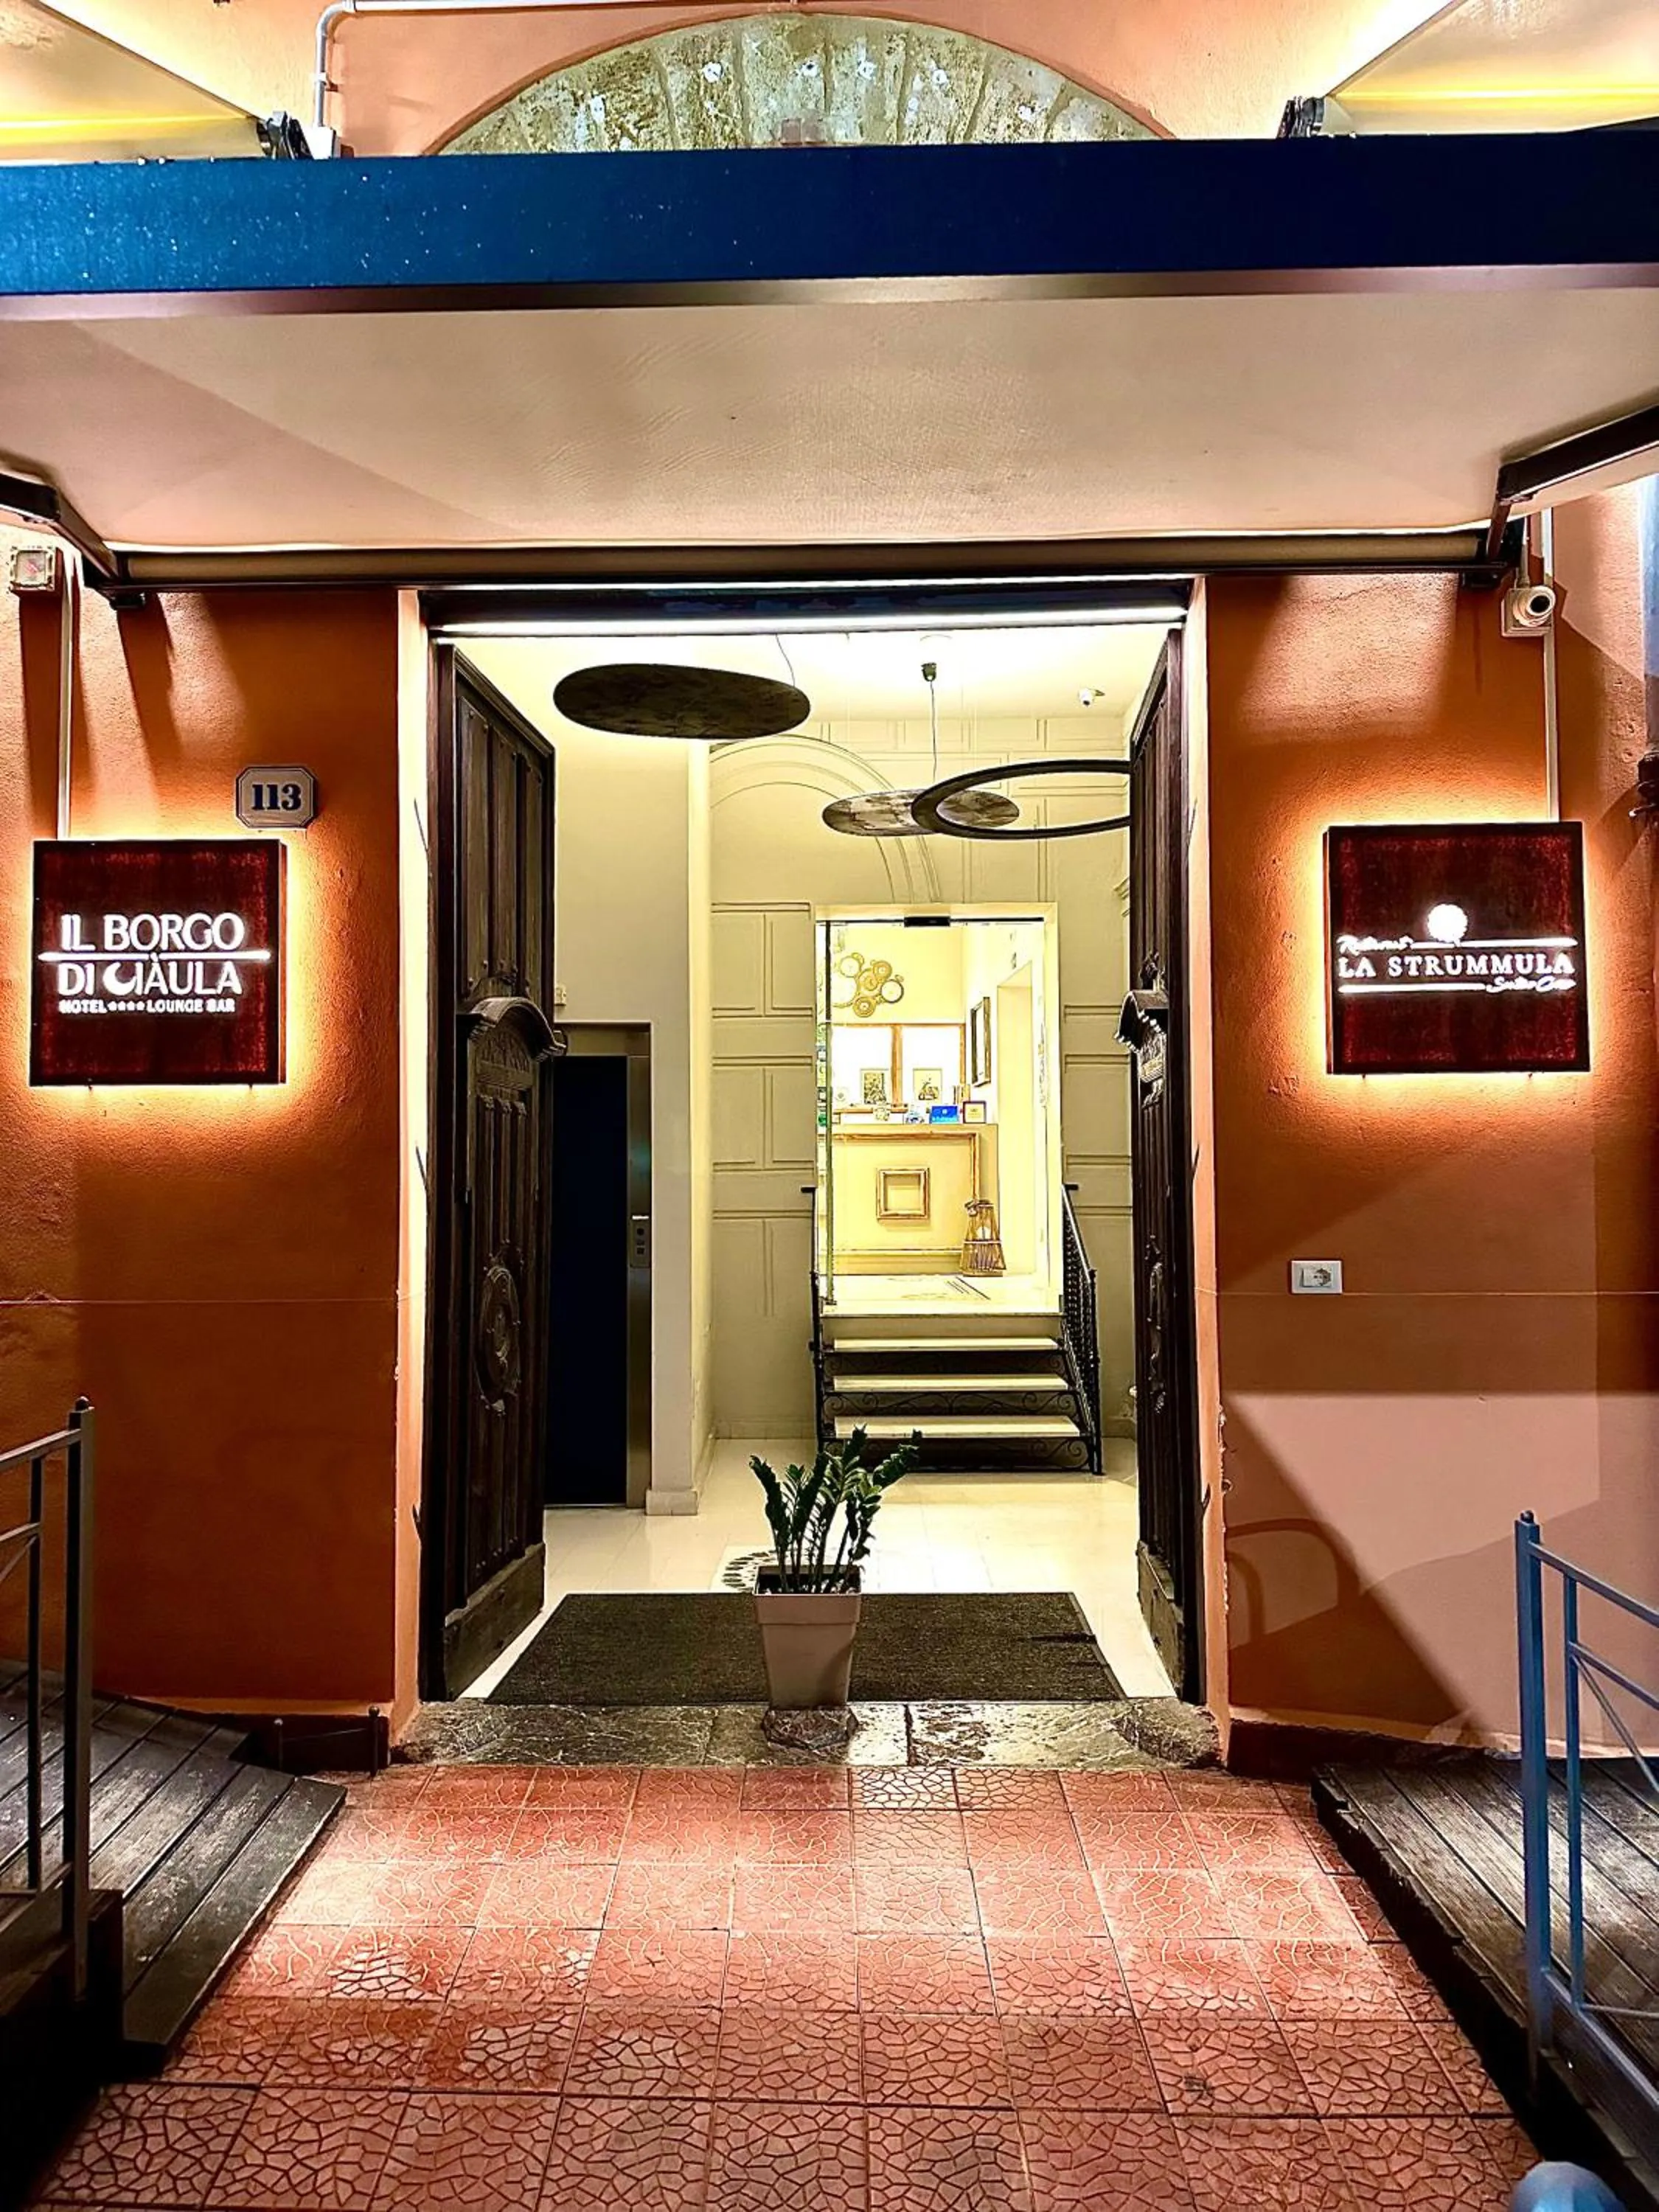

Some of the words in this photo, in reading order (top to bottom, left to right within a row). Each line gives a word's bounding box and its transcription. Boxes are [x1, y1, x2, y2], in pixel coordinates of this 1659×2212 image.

[251, 784, 302, 810] 113
[61, 914, 96, 950] IL
[103, 913, 245, 950] BORGO
[59, 962, 95, 995] DI
[1338, 956, 1376, 978] LA
[1388, 954, 1575, 977] STRUMMULA
[58, 999, 108, 1014] HOTEL
[147, 999, 204, 1012] LOUNGE
[206, 998, 235, 1012] BAR
